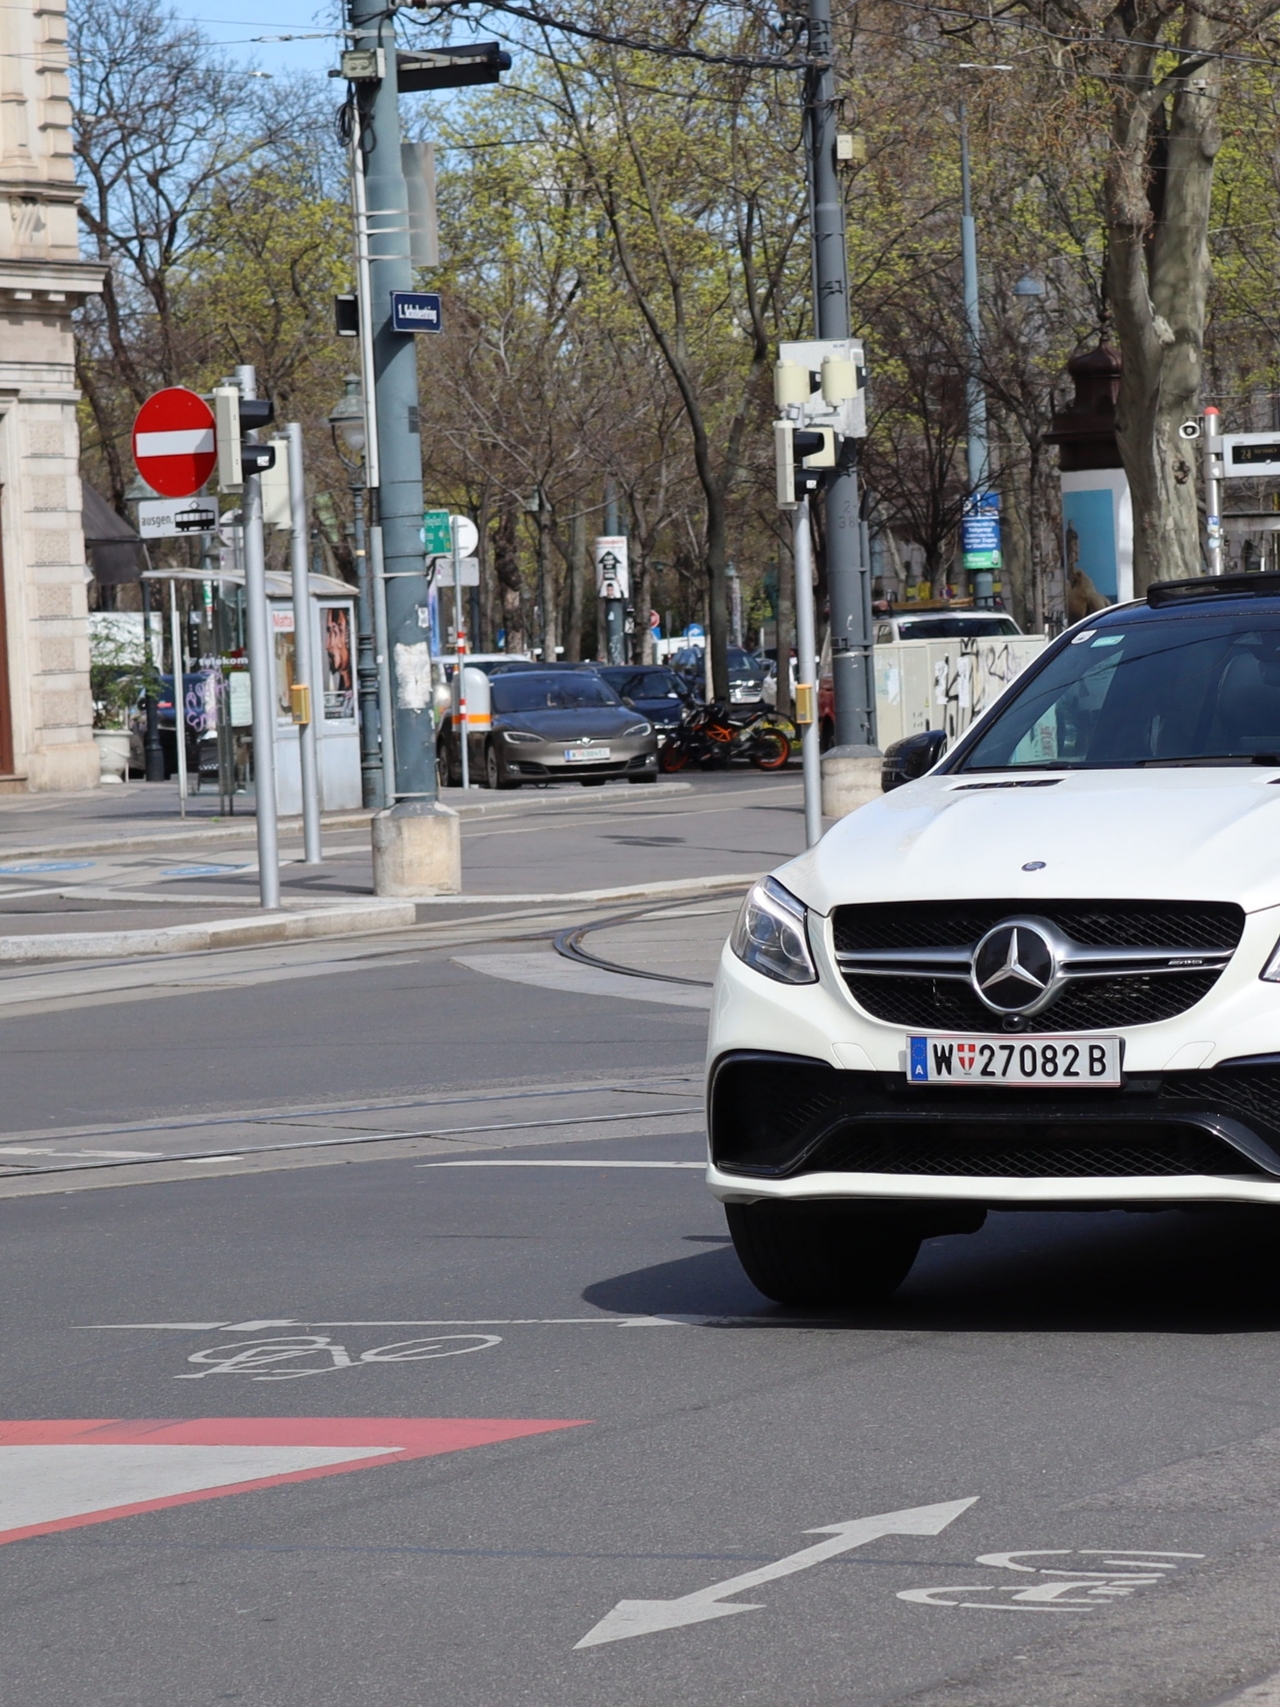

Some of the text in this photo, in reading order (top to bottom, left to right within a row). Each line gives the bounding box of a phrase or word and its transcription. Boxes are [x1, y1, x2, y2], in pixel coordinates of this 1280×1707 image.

[141, 516, 173, 527] ausgen.
[199, 655, 249, 666] telekom
[915, 1043, 1106, 1077] A W 27082 B
